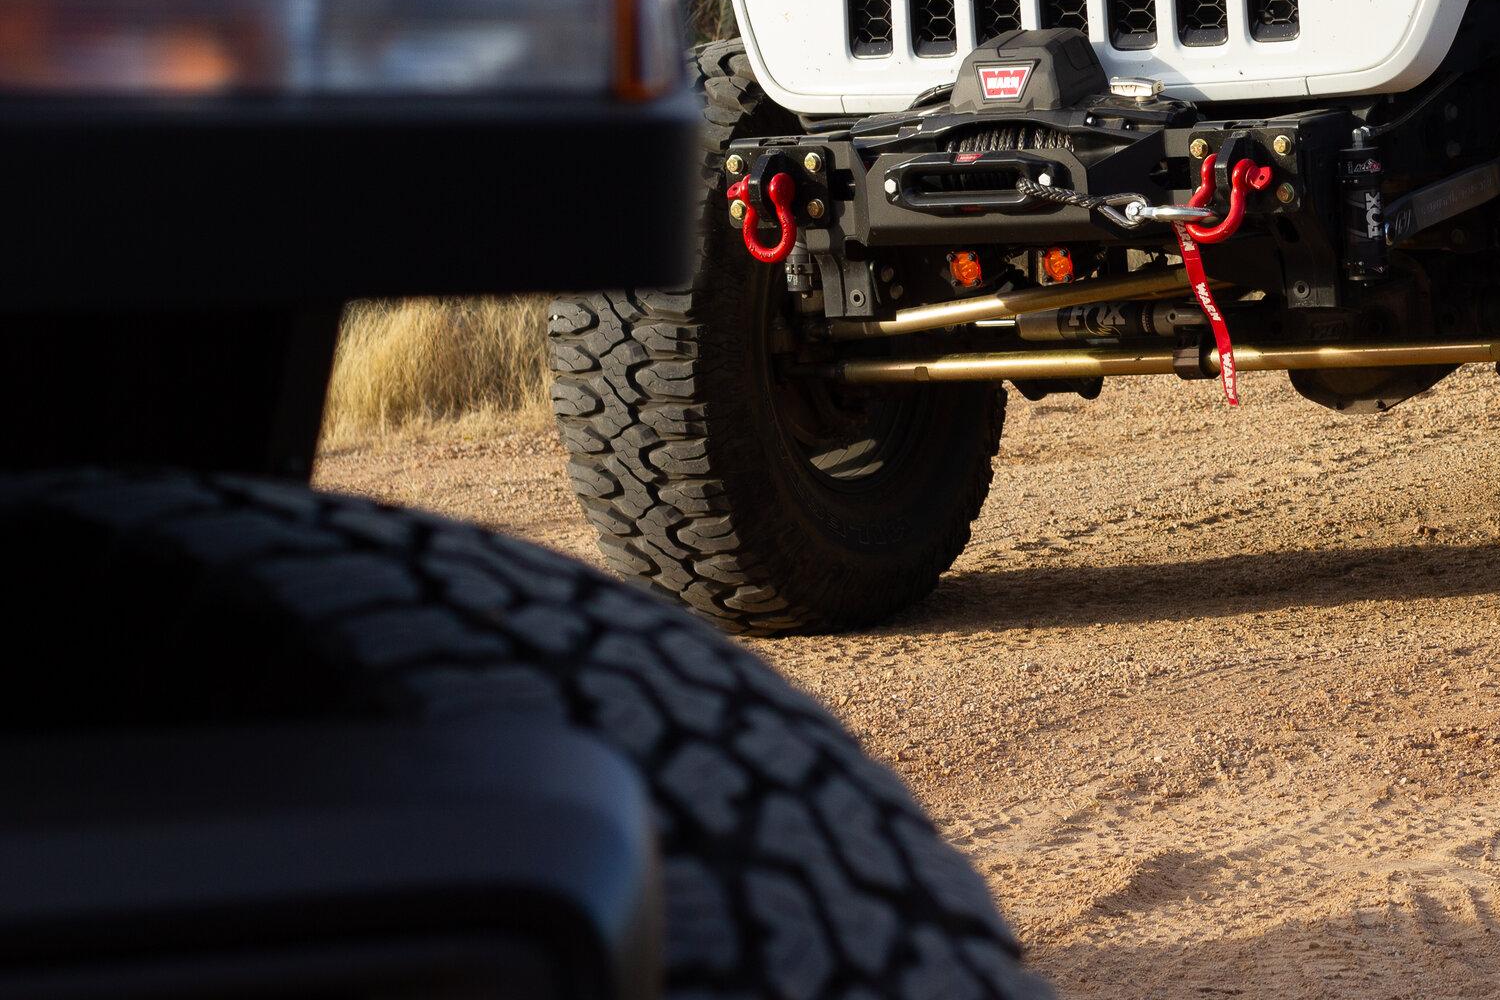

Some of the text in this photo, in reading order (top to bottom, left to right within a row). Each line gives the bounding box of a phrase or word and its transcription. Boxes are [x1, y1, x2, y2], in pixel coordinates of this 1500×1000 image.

[986, 76, 1020, 89] WARN
[1365, 191, 1383, 239] FOX
[1068, 302, 1126, 327] FOX
[1195, 282, 1222, 322] WARN
[1221, 351, 1237, 400] WARN
